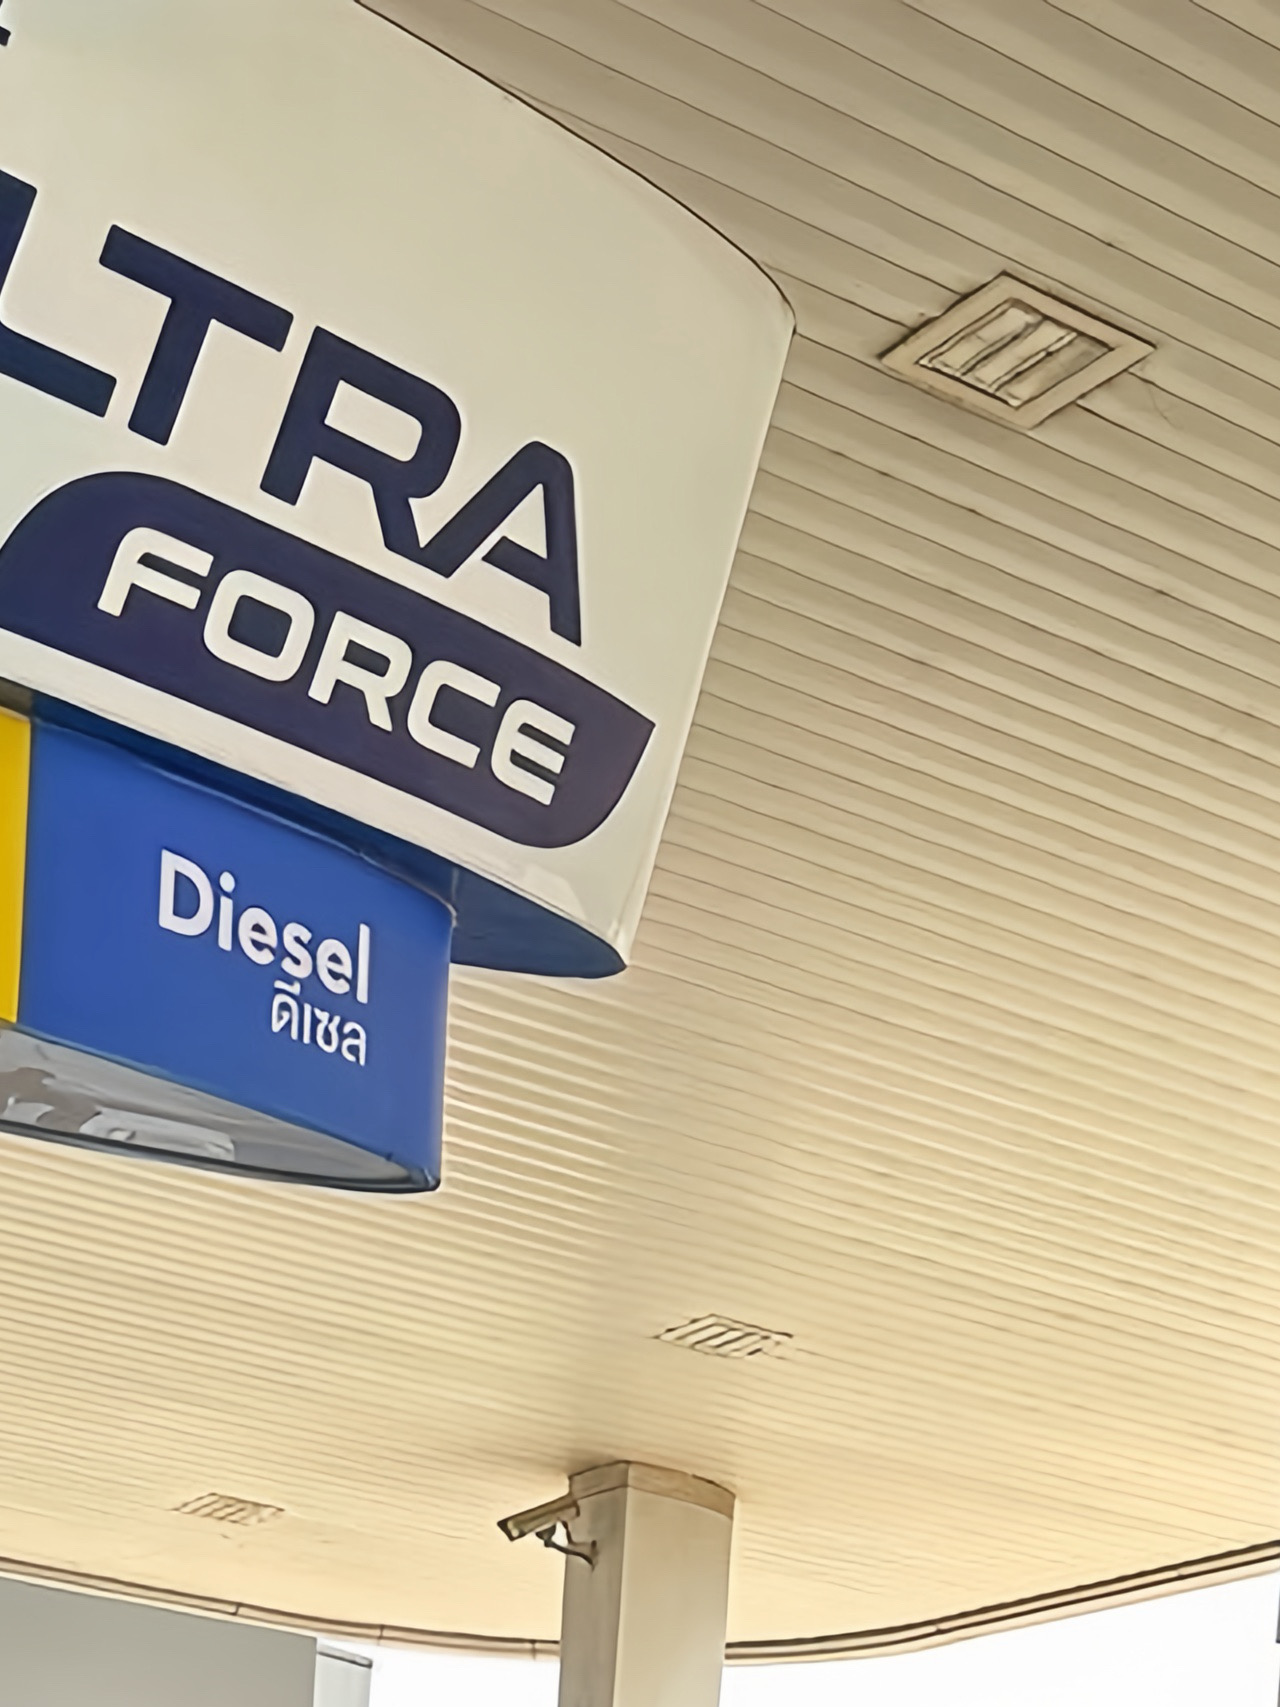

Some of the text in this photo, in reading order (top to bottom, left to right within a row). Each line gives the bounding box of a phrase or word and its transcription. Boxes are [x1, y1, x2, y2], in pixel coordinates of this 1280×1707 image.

[96, 526, 576, 807] FORCE
[158, 847, 371, 1005] Diesel
[270, 979, 368, 1068] ดีเซล
